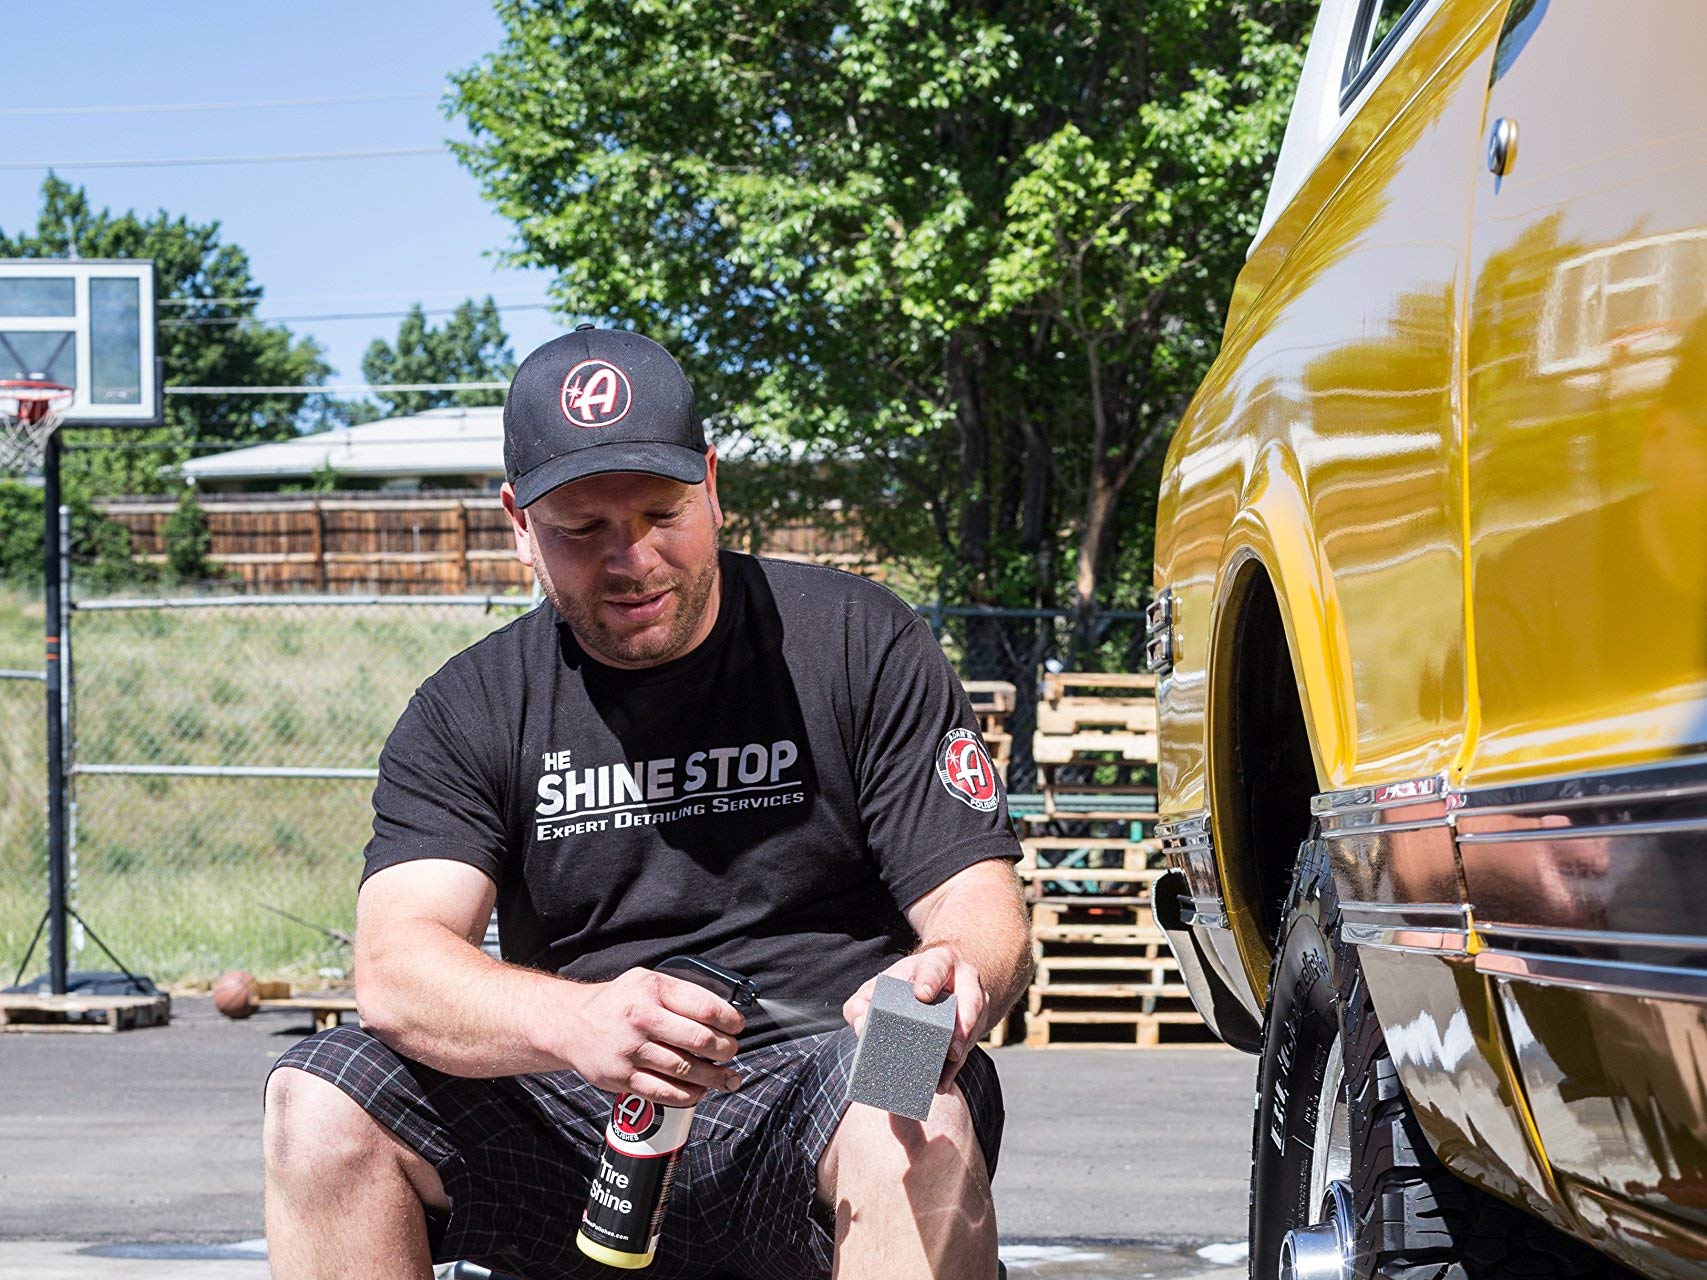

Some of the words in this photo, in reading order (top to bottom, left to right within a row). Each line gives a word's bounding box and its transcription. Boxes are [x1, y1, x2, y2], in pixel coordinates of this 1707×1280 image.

[535, 757, 674, 816] SHINE
[682, 740, 798, 792] STOP
[541, 749, 571, 772] HE
[537, 819, 609, 841] EXPERT
[711, 792, 804, 814] SERVICES
[600, 1154, 629, 1189] Tire
[590, 1178, 632, 1214] Shine
